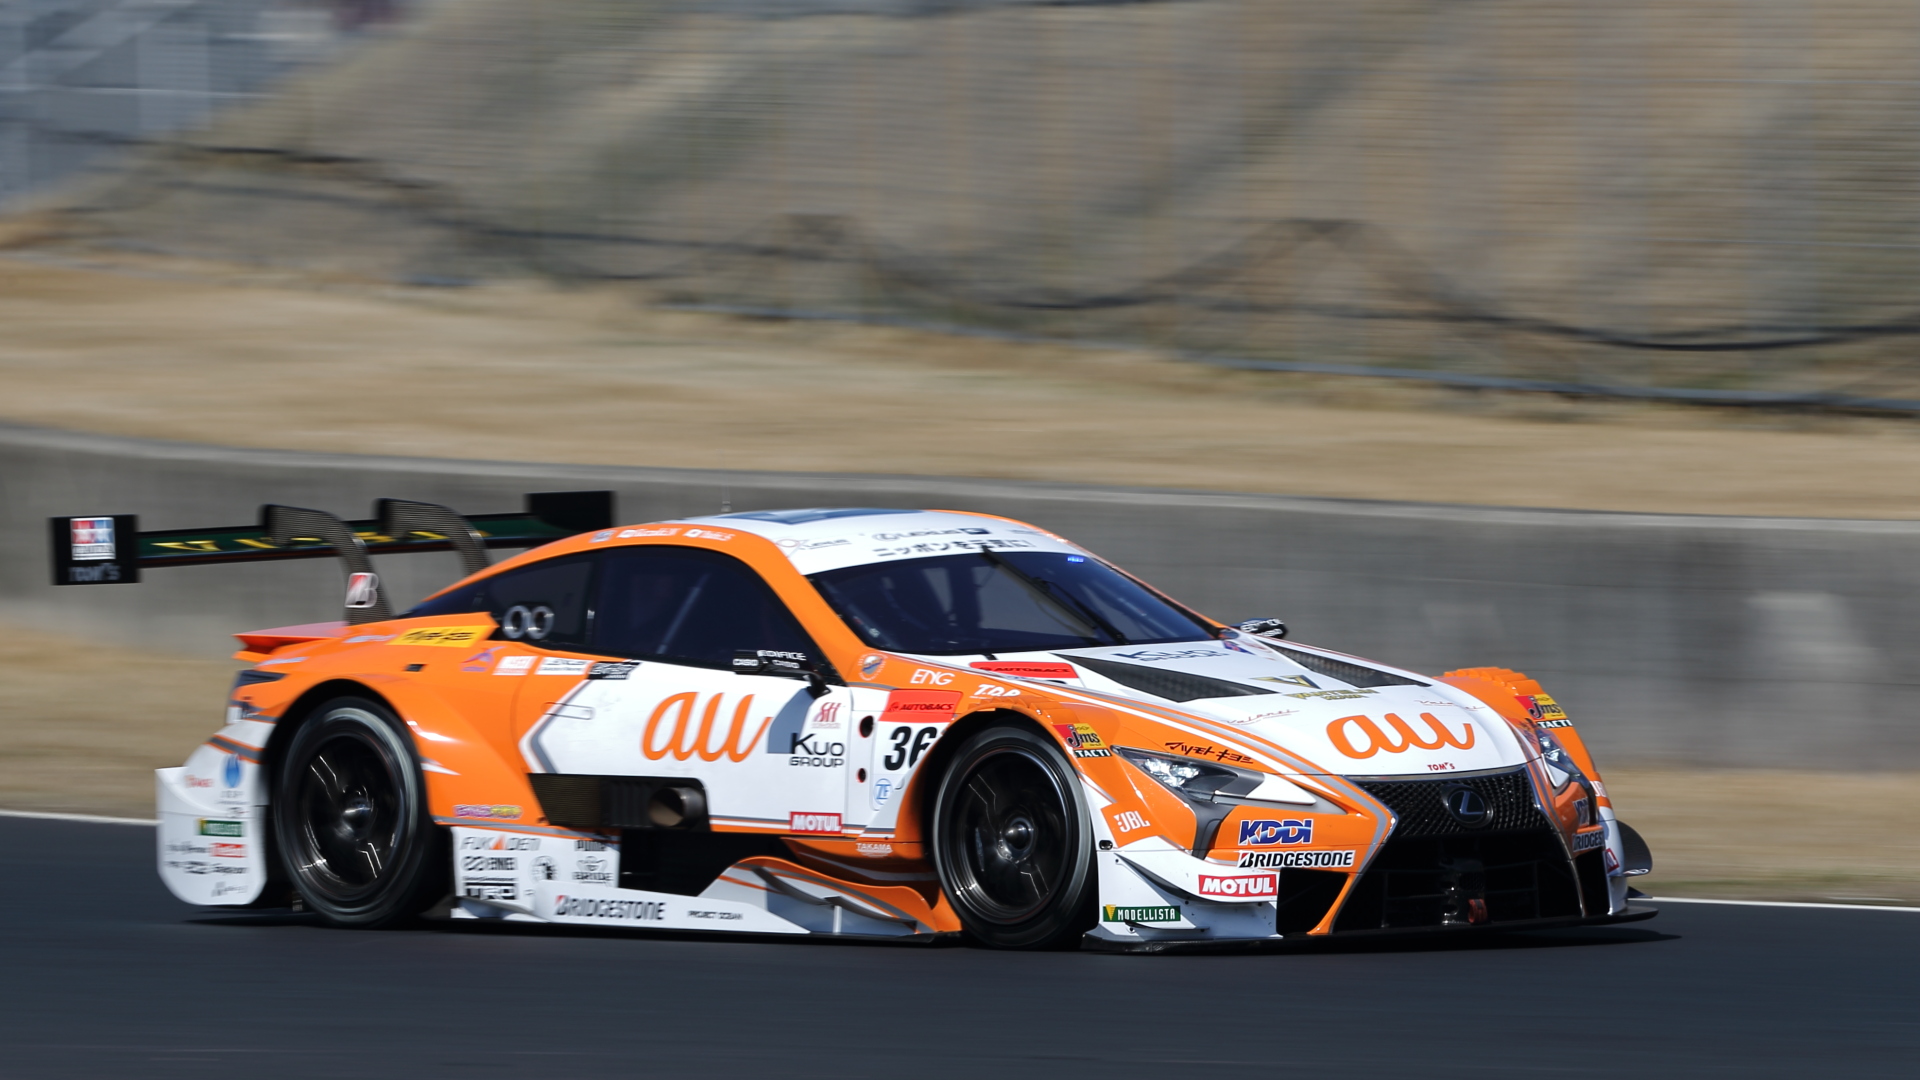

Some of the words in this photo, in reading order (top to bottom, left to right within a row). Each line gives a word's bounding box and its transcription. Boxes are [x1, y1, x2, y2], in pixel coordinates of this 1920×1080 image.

[910, 669, 955, 685] ENG
[900, 703, 954, 711] AUTOBACS
[641, 691, 774, 763] au
[1538, 720, 1572, 728] TACTI
[1326, 712, 1475, 760] au
[884, 726, 938, 771] 36
[1075, 749, 1111, 758] TACTI
[790, 756, 844, 767] GROUP
[1427, 762, 1455, 771] TOM'S
[792, 814, 841, 833] MOTUL
[1119, 811, 1150, 832] JBL
[1239, 820, 1313, 844] KDDI
[1238, 851, 1355, 868] BRIDGESTONE
[1202, 877, 1274, 894] MOTUL
[554, 895, 667, 920] BRIDGESTONE
[1117, 907, 1176, 922] MODELLISTA
